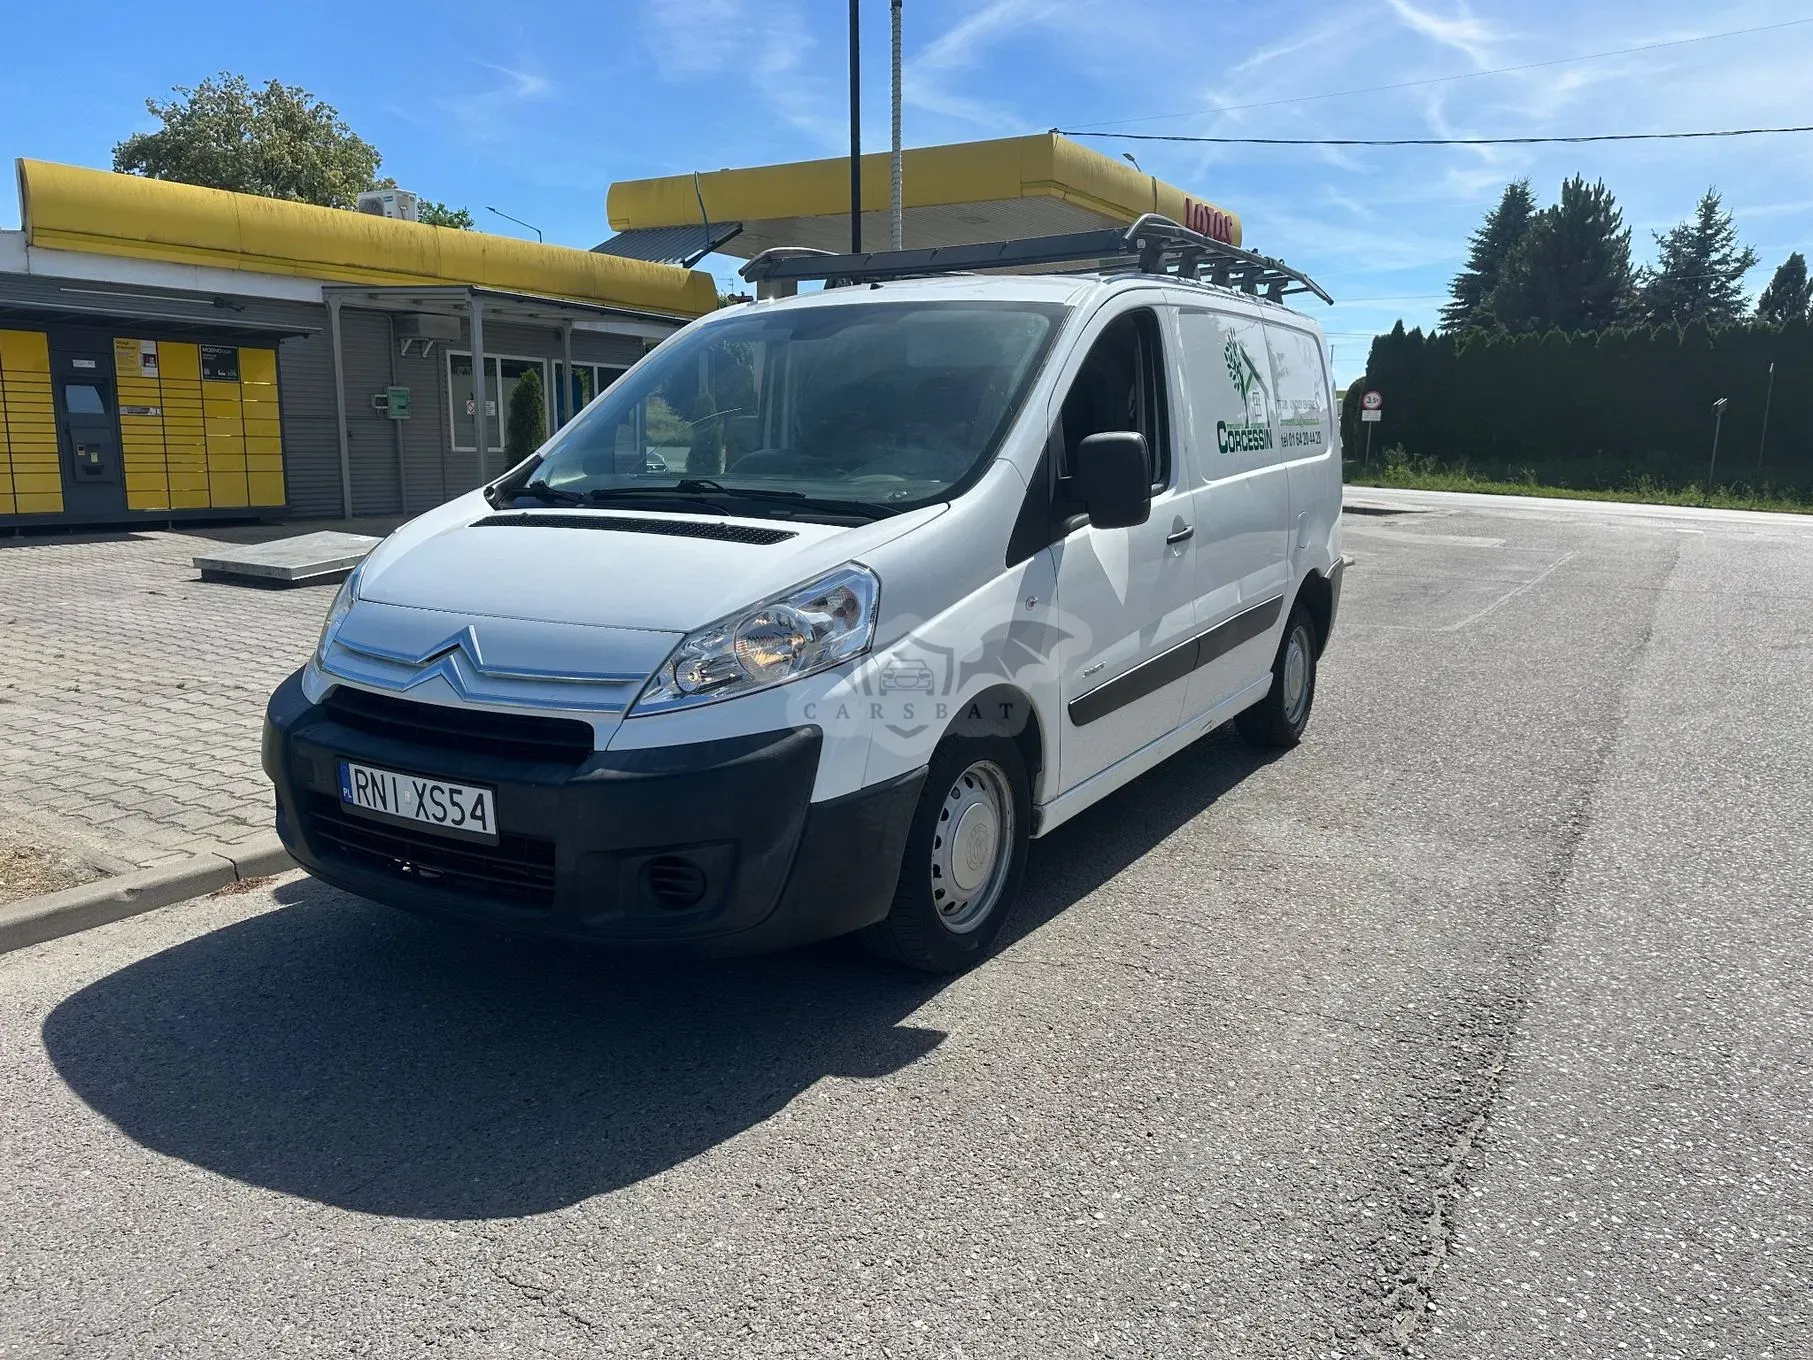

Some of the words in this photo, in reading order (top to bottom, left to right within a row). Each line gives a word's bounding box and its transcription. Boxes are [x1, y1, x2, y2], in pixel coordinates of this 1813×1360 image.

[1184, 197, 1233, 245] LOTOS
[1217, 420, 1272, 454] CORCESSIN
[343, 787, 352, 799] PL
[354, 768, 399, 813] RNI
[412, 780, 487, 831] XS54
